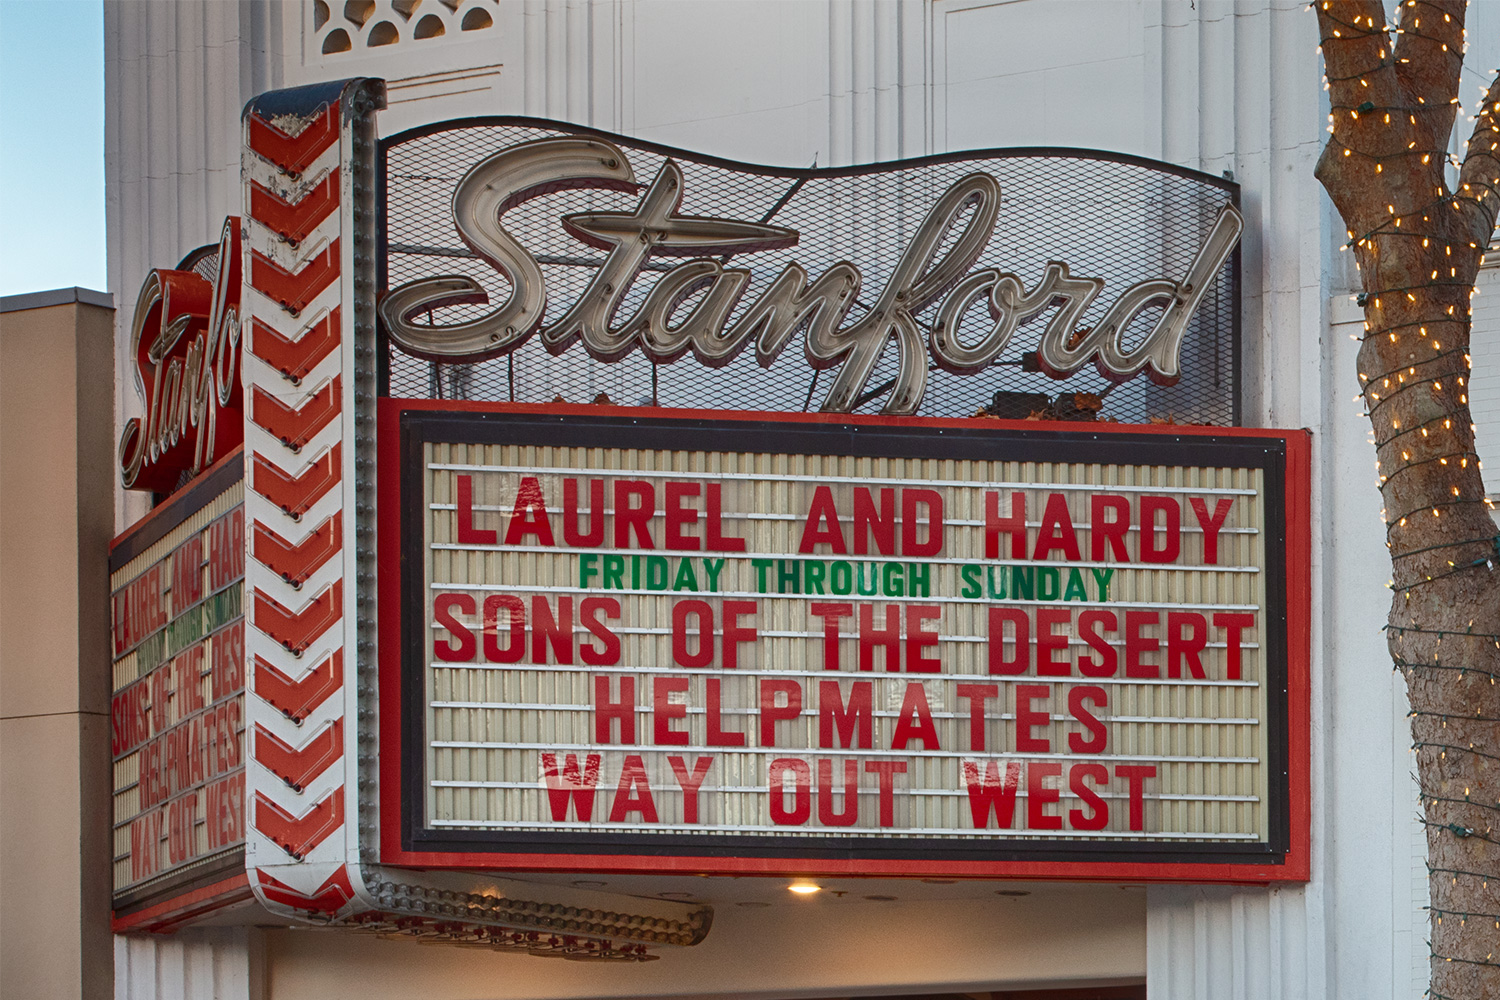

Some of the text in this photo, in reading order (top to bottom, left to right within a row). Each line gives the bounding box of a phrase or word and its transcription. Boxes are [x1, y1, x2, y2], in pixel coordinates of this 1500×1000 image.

[380, 134, 1245, 416] Stanford
[457, 475, 1234, 565] LAUREL AND HARDY
[114, 565, 167, 655] LAUREL
[172, 537, 202, 618] AND
[579, 553, 1114, 603] FRIDAY THROUGH SUNDAY
[433, 592, 1254, 680] SONS OF THE DESERT
[112, 680, 149, 757] SONS
[152, 666, 170, 733] OF
[175, 645, 203, 719] THE
[594, 675, 1108, 754] HELPMATES
[139, 701, 240, 812] HELPMATES
[541, 753, 1156, 831] WAY OUT WEST
[131, 810, 164, 882] WAY
[168, 793, 198, 865] OUT
